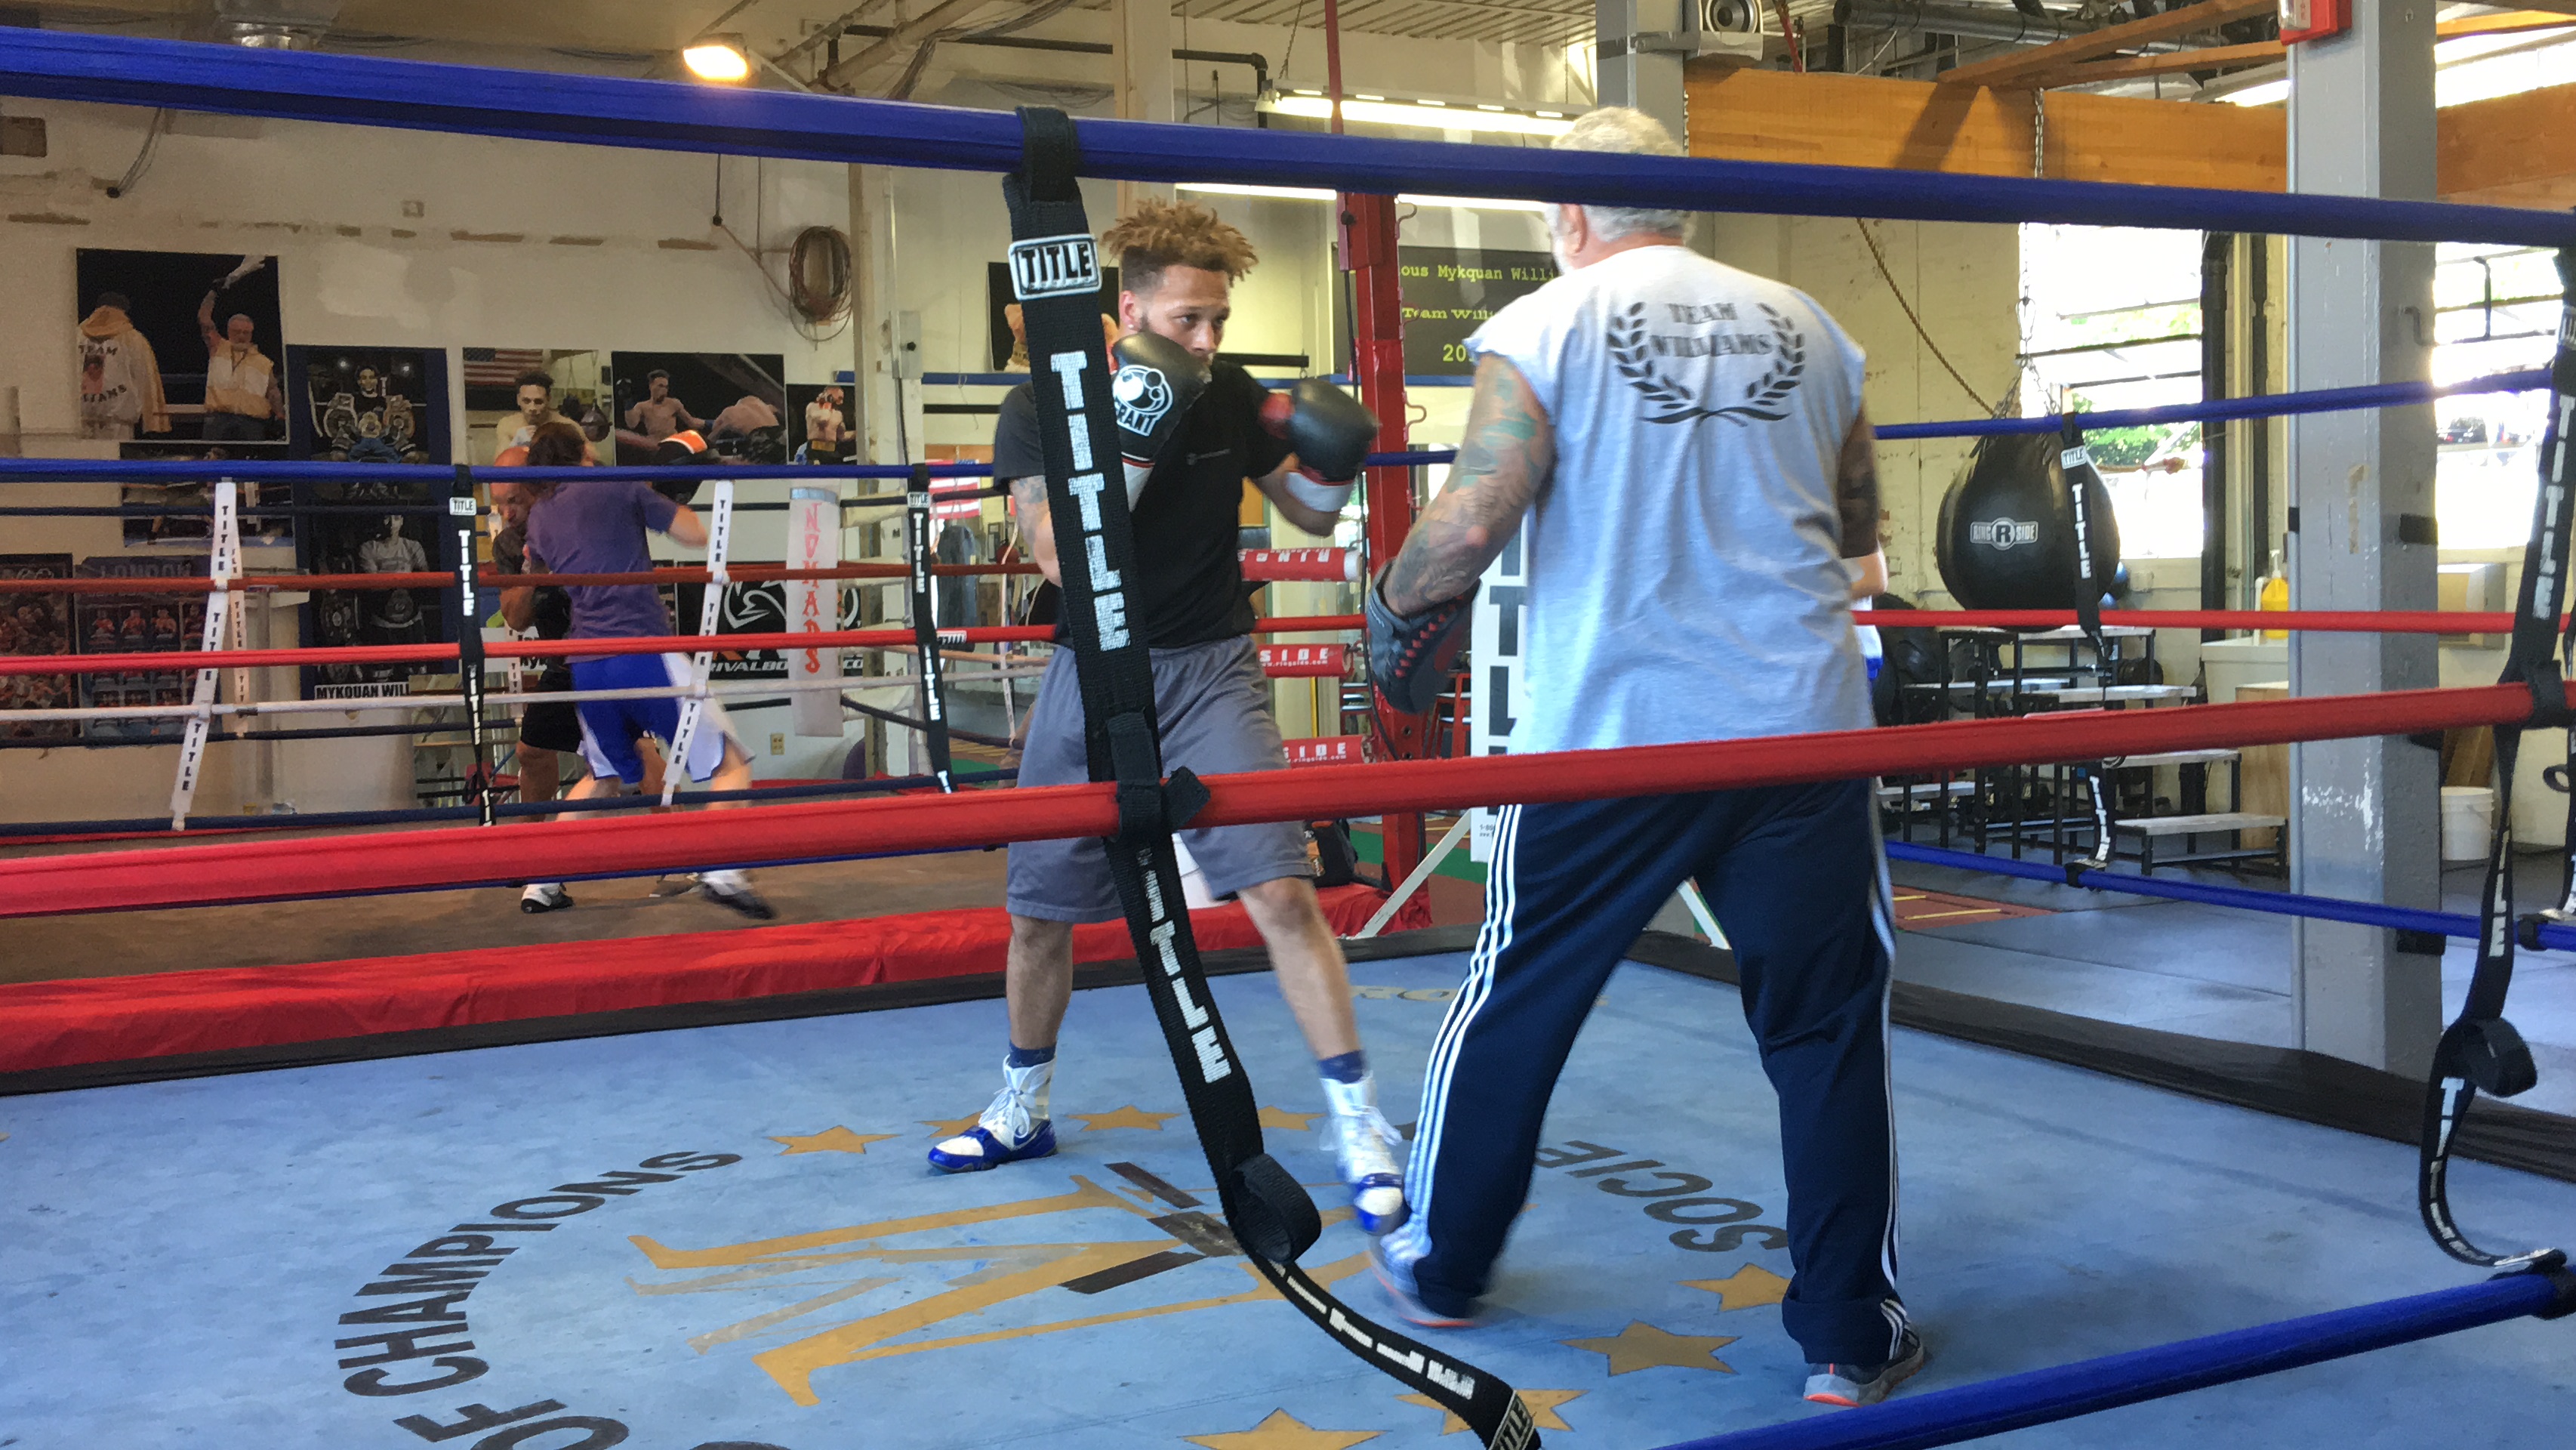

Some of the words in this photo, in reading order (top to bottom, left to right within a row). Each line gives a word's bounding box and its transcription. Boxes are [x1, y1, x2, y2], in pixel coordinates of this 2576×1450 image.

[1019, 244, 1092, 283] TITLE
[1437, 264, 1502, 282] Mykquan
[1401, 307, 1448, 319] Team
[1650, 333, 1773, 357] WILLIAMS
[1667, 302, 1737, 323] TEAM
[1115, 403, 1157, 433] RANT
[453, 499, 474, 514] TITLE
[715, 499, 726, 563] TITLE
[1049, 350, 1130, 652] TITLE
[2072, 482, 2092, 579] TITLE
[2531, 393, 2575, 620] TITLE
[217, 505, 228, 571] TITLE
[914, 512, 926, 594] TITLE
[458, 529, 475, 616] TITLE
[205, 612, 220, 681] TITE
[699, 603, 716, 666] TITE
[182, 723, 202, 791] TITLE
[674, 702, 696, 765] TITLE
[2089, 775, 2111, 861] TITLE
[334, 1150, 744, 1397] CHAMPIONS
[1270, 1258, 1476, 1400] ITLE
